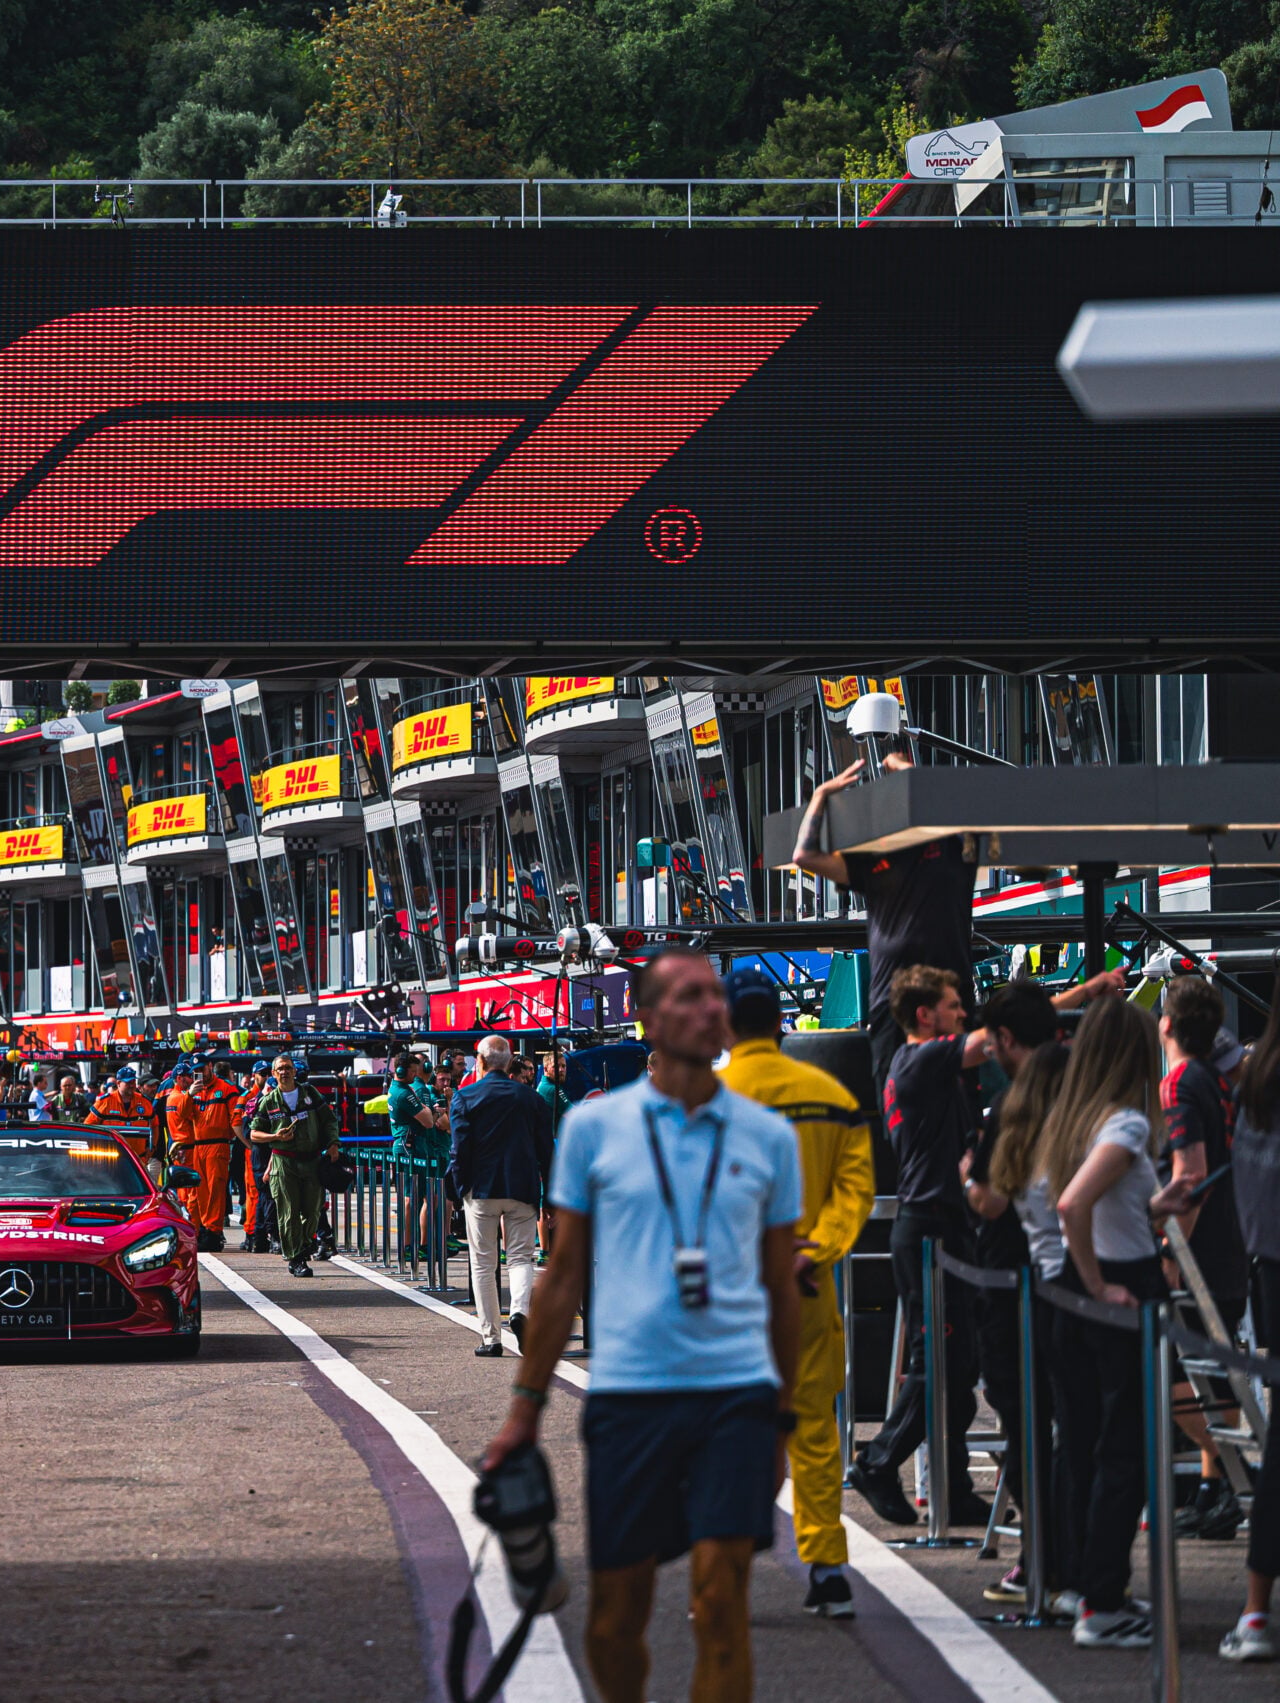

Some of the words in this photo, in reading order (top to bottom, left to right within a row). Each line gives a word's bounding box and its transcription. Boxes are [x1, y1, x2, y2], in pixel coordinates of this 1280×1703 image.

[412, 715, 451, 753] DHL
[284, 764, 320, 797] DHL
[152, 802, 187, 832] DHL
[5, 833, 42, 858] DHL
[534, 941, 558, 951] TG
[28, 1314, 53, 1324] CAR
